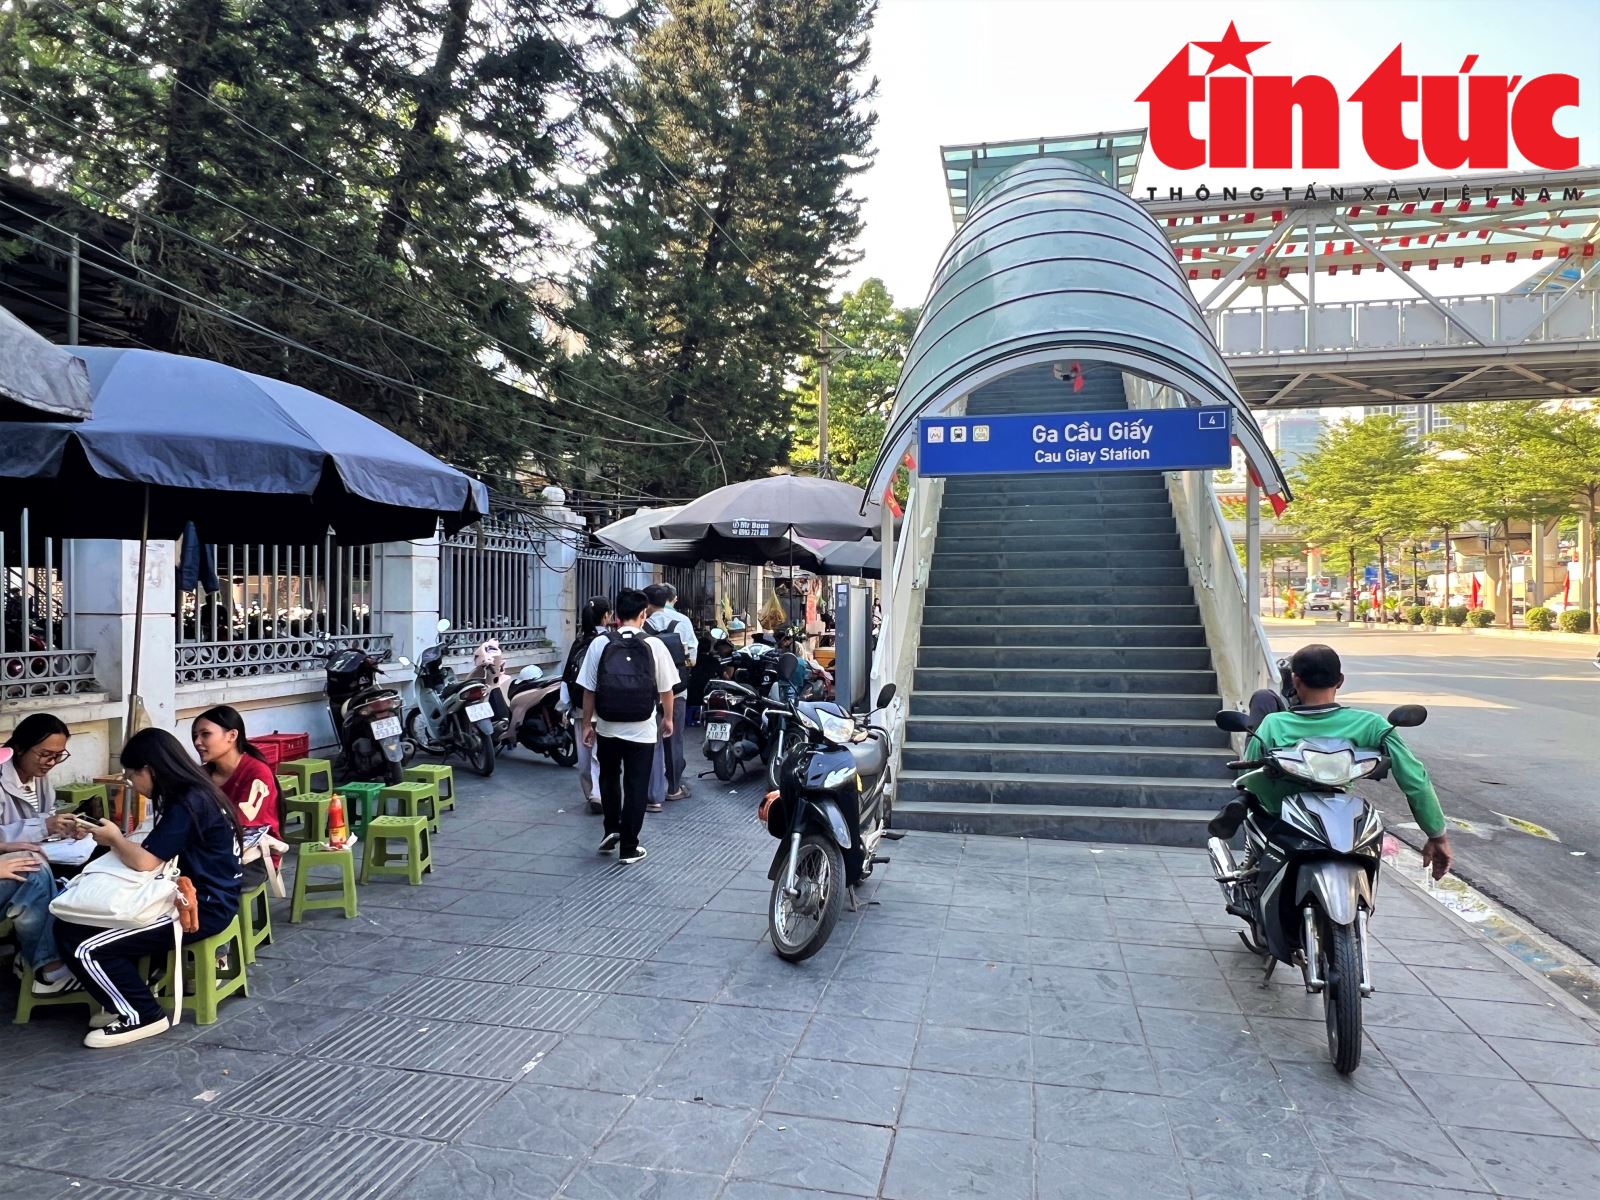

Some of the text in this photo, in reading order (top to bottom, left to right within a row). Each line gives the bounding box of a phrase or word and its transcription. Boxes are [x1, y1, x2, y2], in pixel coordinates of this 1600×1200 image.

[1208, 415, 1216, 424] 4
[1032, 418, 1153, 443] Ga Cầu Giấy
[1034, 446, 1150, 464] Cau Giay Station
